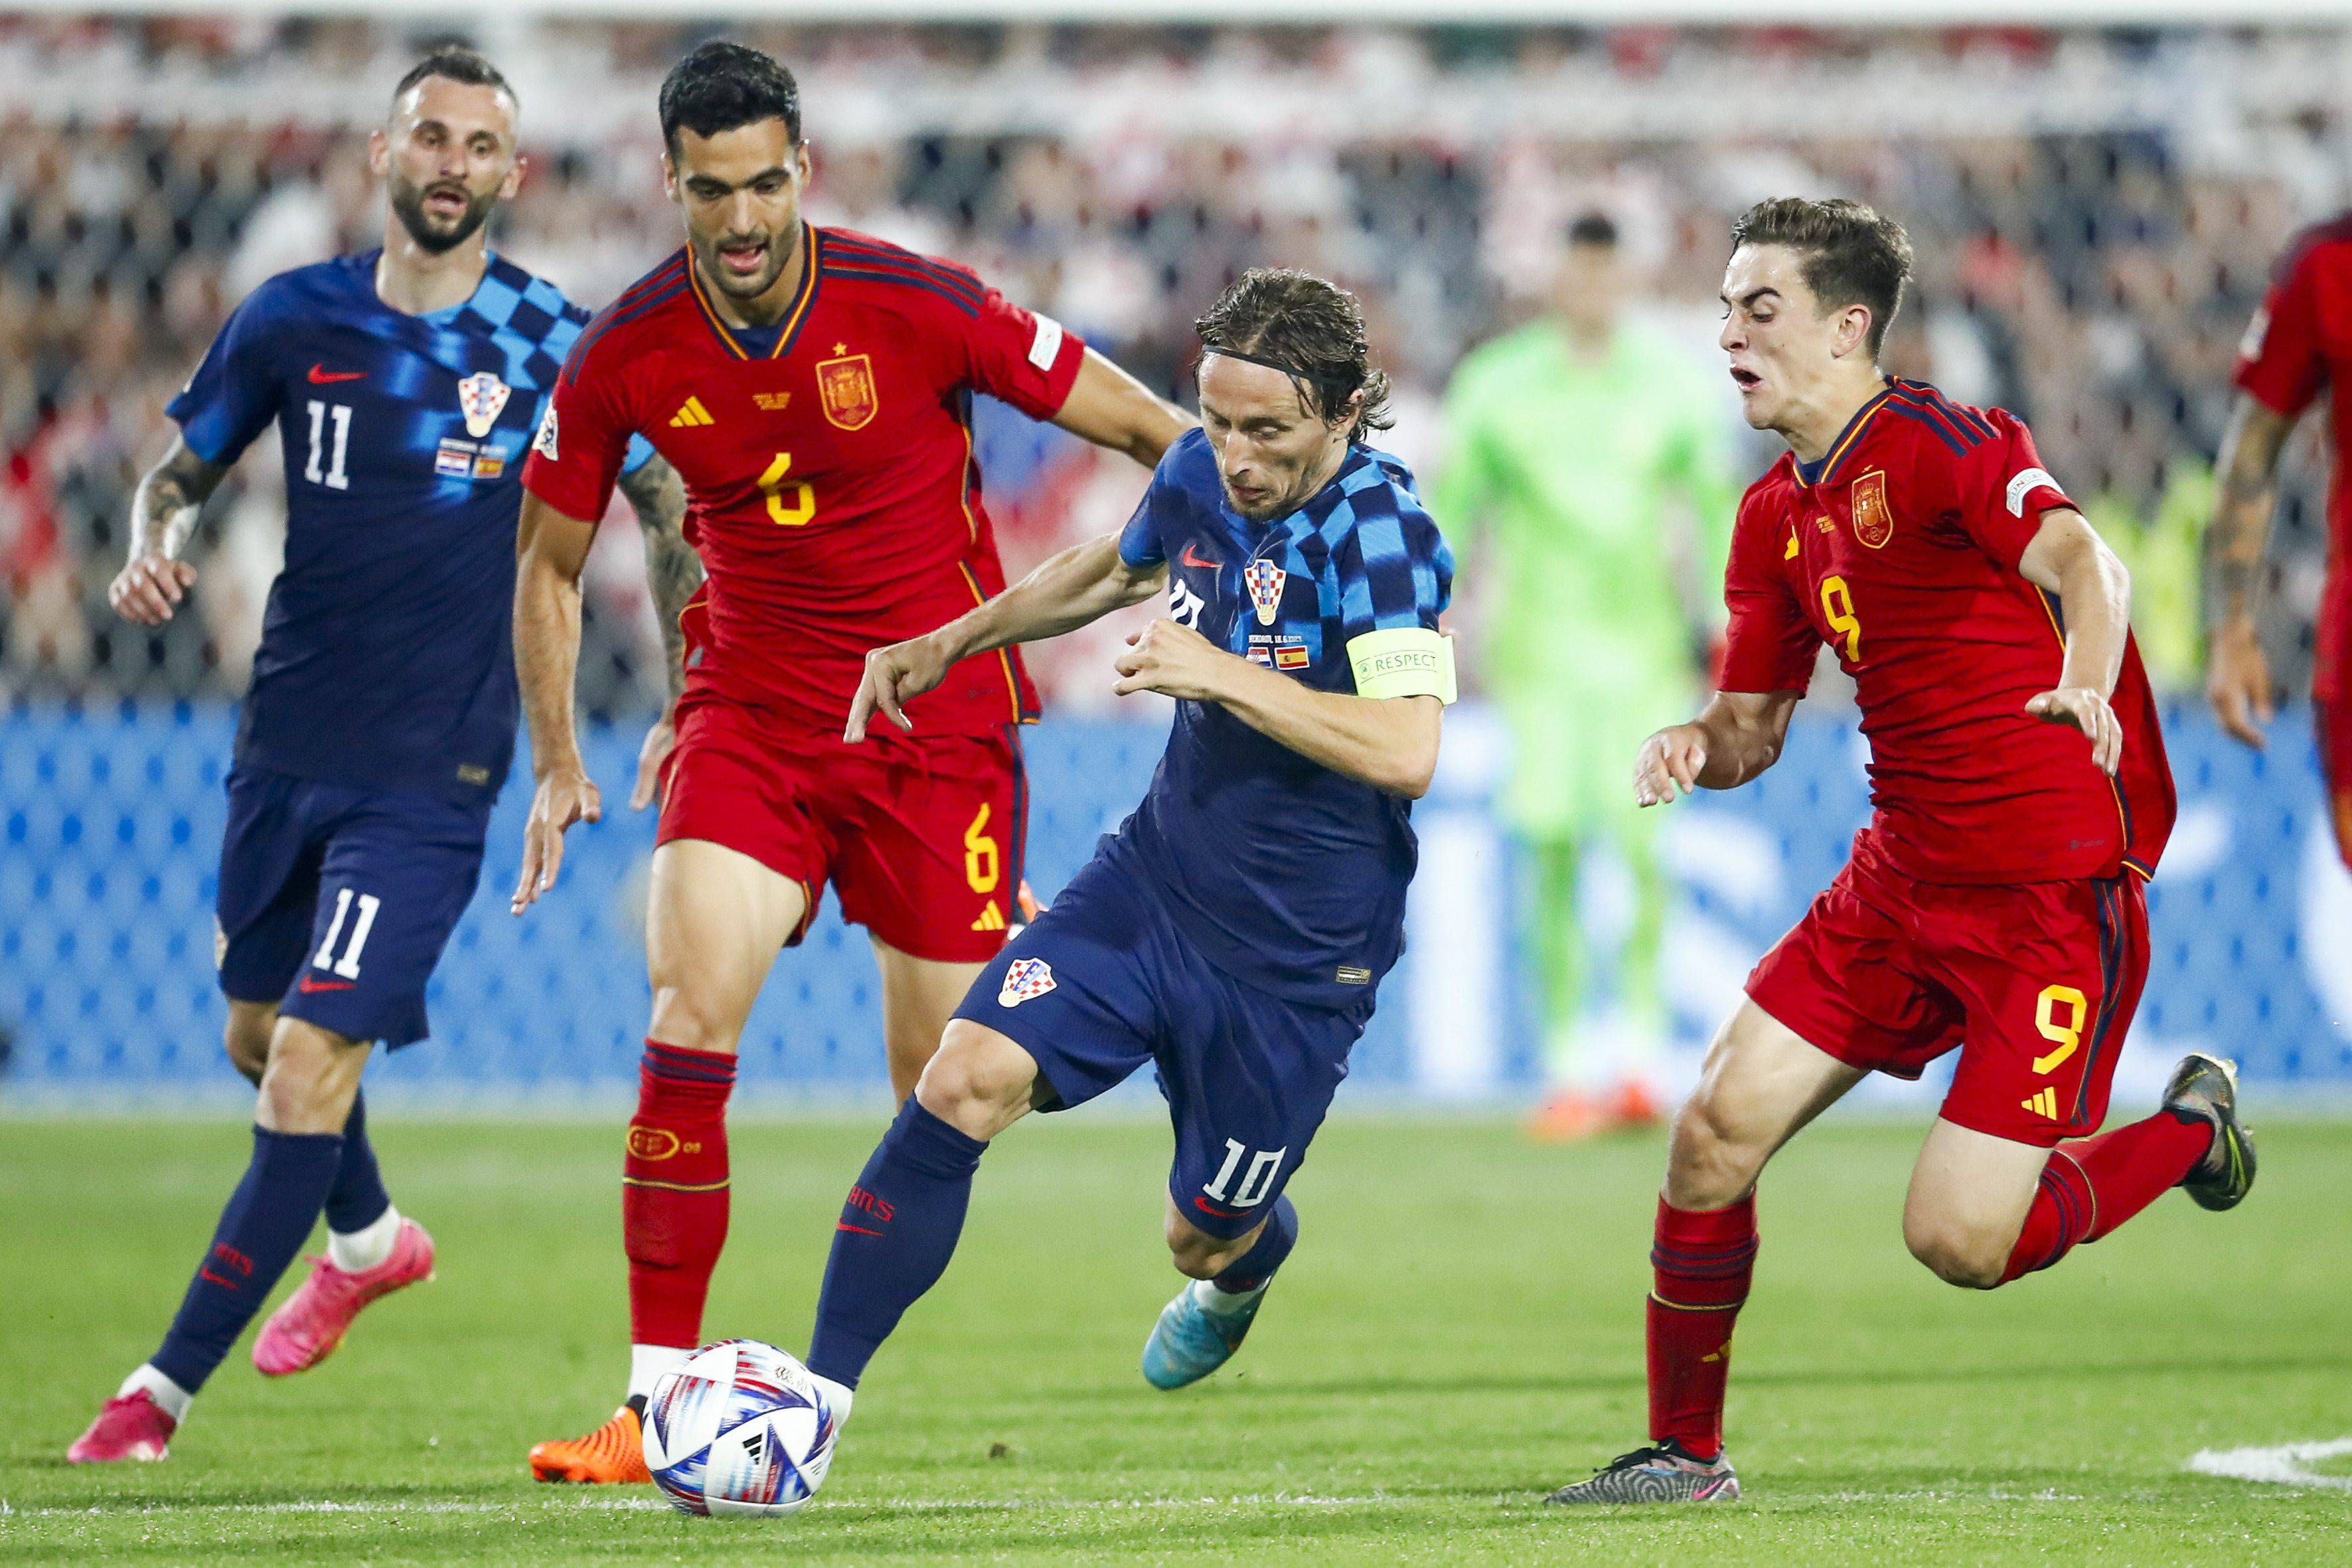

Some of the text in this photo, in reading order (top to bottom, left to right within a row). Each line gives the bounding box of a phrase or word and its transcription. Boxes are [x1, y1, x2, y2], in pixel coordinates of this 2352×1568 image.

[304, 400, 352, 491] 11
[757, 453, 816, 526] 6
[1375, 653, 1436, 672] RESPECT
[1820, 575, 1860, 663] 9
[964, 802, 999, 894] 6
[313, 888, 380, 980] 11
[2031, 984, 2087, 1075] 9
[1202, 1137, 1287, 1208] 10
